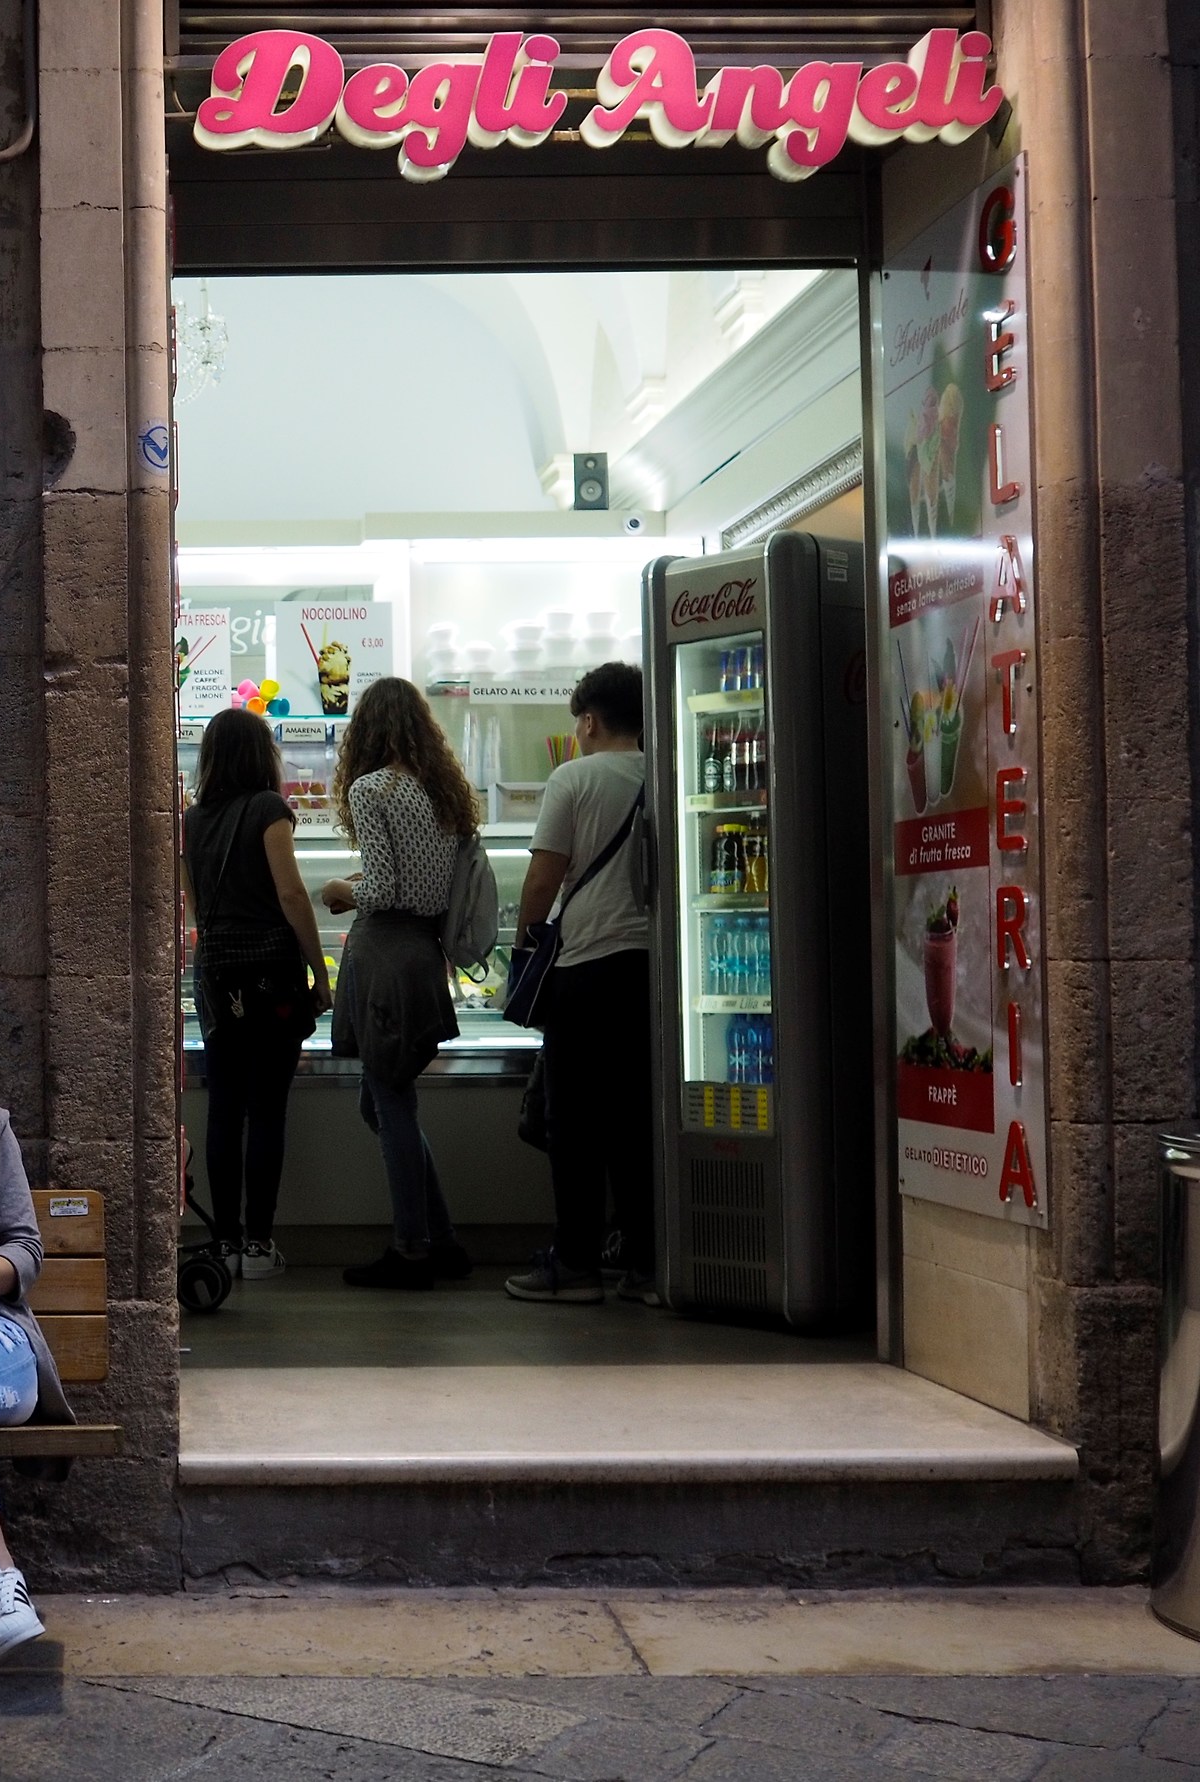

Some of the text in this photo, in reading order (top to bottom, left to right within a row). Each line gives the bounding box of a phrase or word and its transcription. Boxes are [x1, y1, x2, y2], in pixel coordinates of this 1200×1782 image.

[194, 28, 1004, 184] Degli Angeli
[890, 288, 969, 367] Artigianale
[894, 571, 924, 597] GELATO
[896, 574, 976, 617] senza latte e lattosio
[302, 608, 367, 620] NOCCIOLINO
[671, 577, 757, 628] Coca-Cola
[195, 614, 227, 626] FRESCA
[368, 638, 383, 648] 3,00
[473, 688, 508, 696] GELATO
[511, 688, 522, 696] AL
[524, 688, 537, 696] KG
[549, 688, 573, 697] 14,00
[979, 186, 1038, 1208] GELATERIA
[921, 822, 956, 843] GRANITE
[909, 843, 971, 865] di frutta fresca
[928, 1084, 958, 1106] FRAPPÈ
[905, 1146, 988, 1177] GELATO DIETETICO
